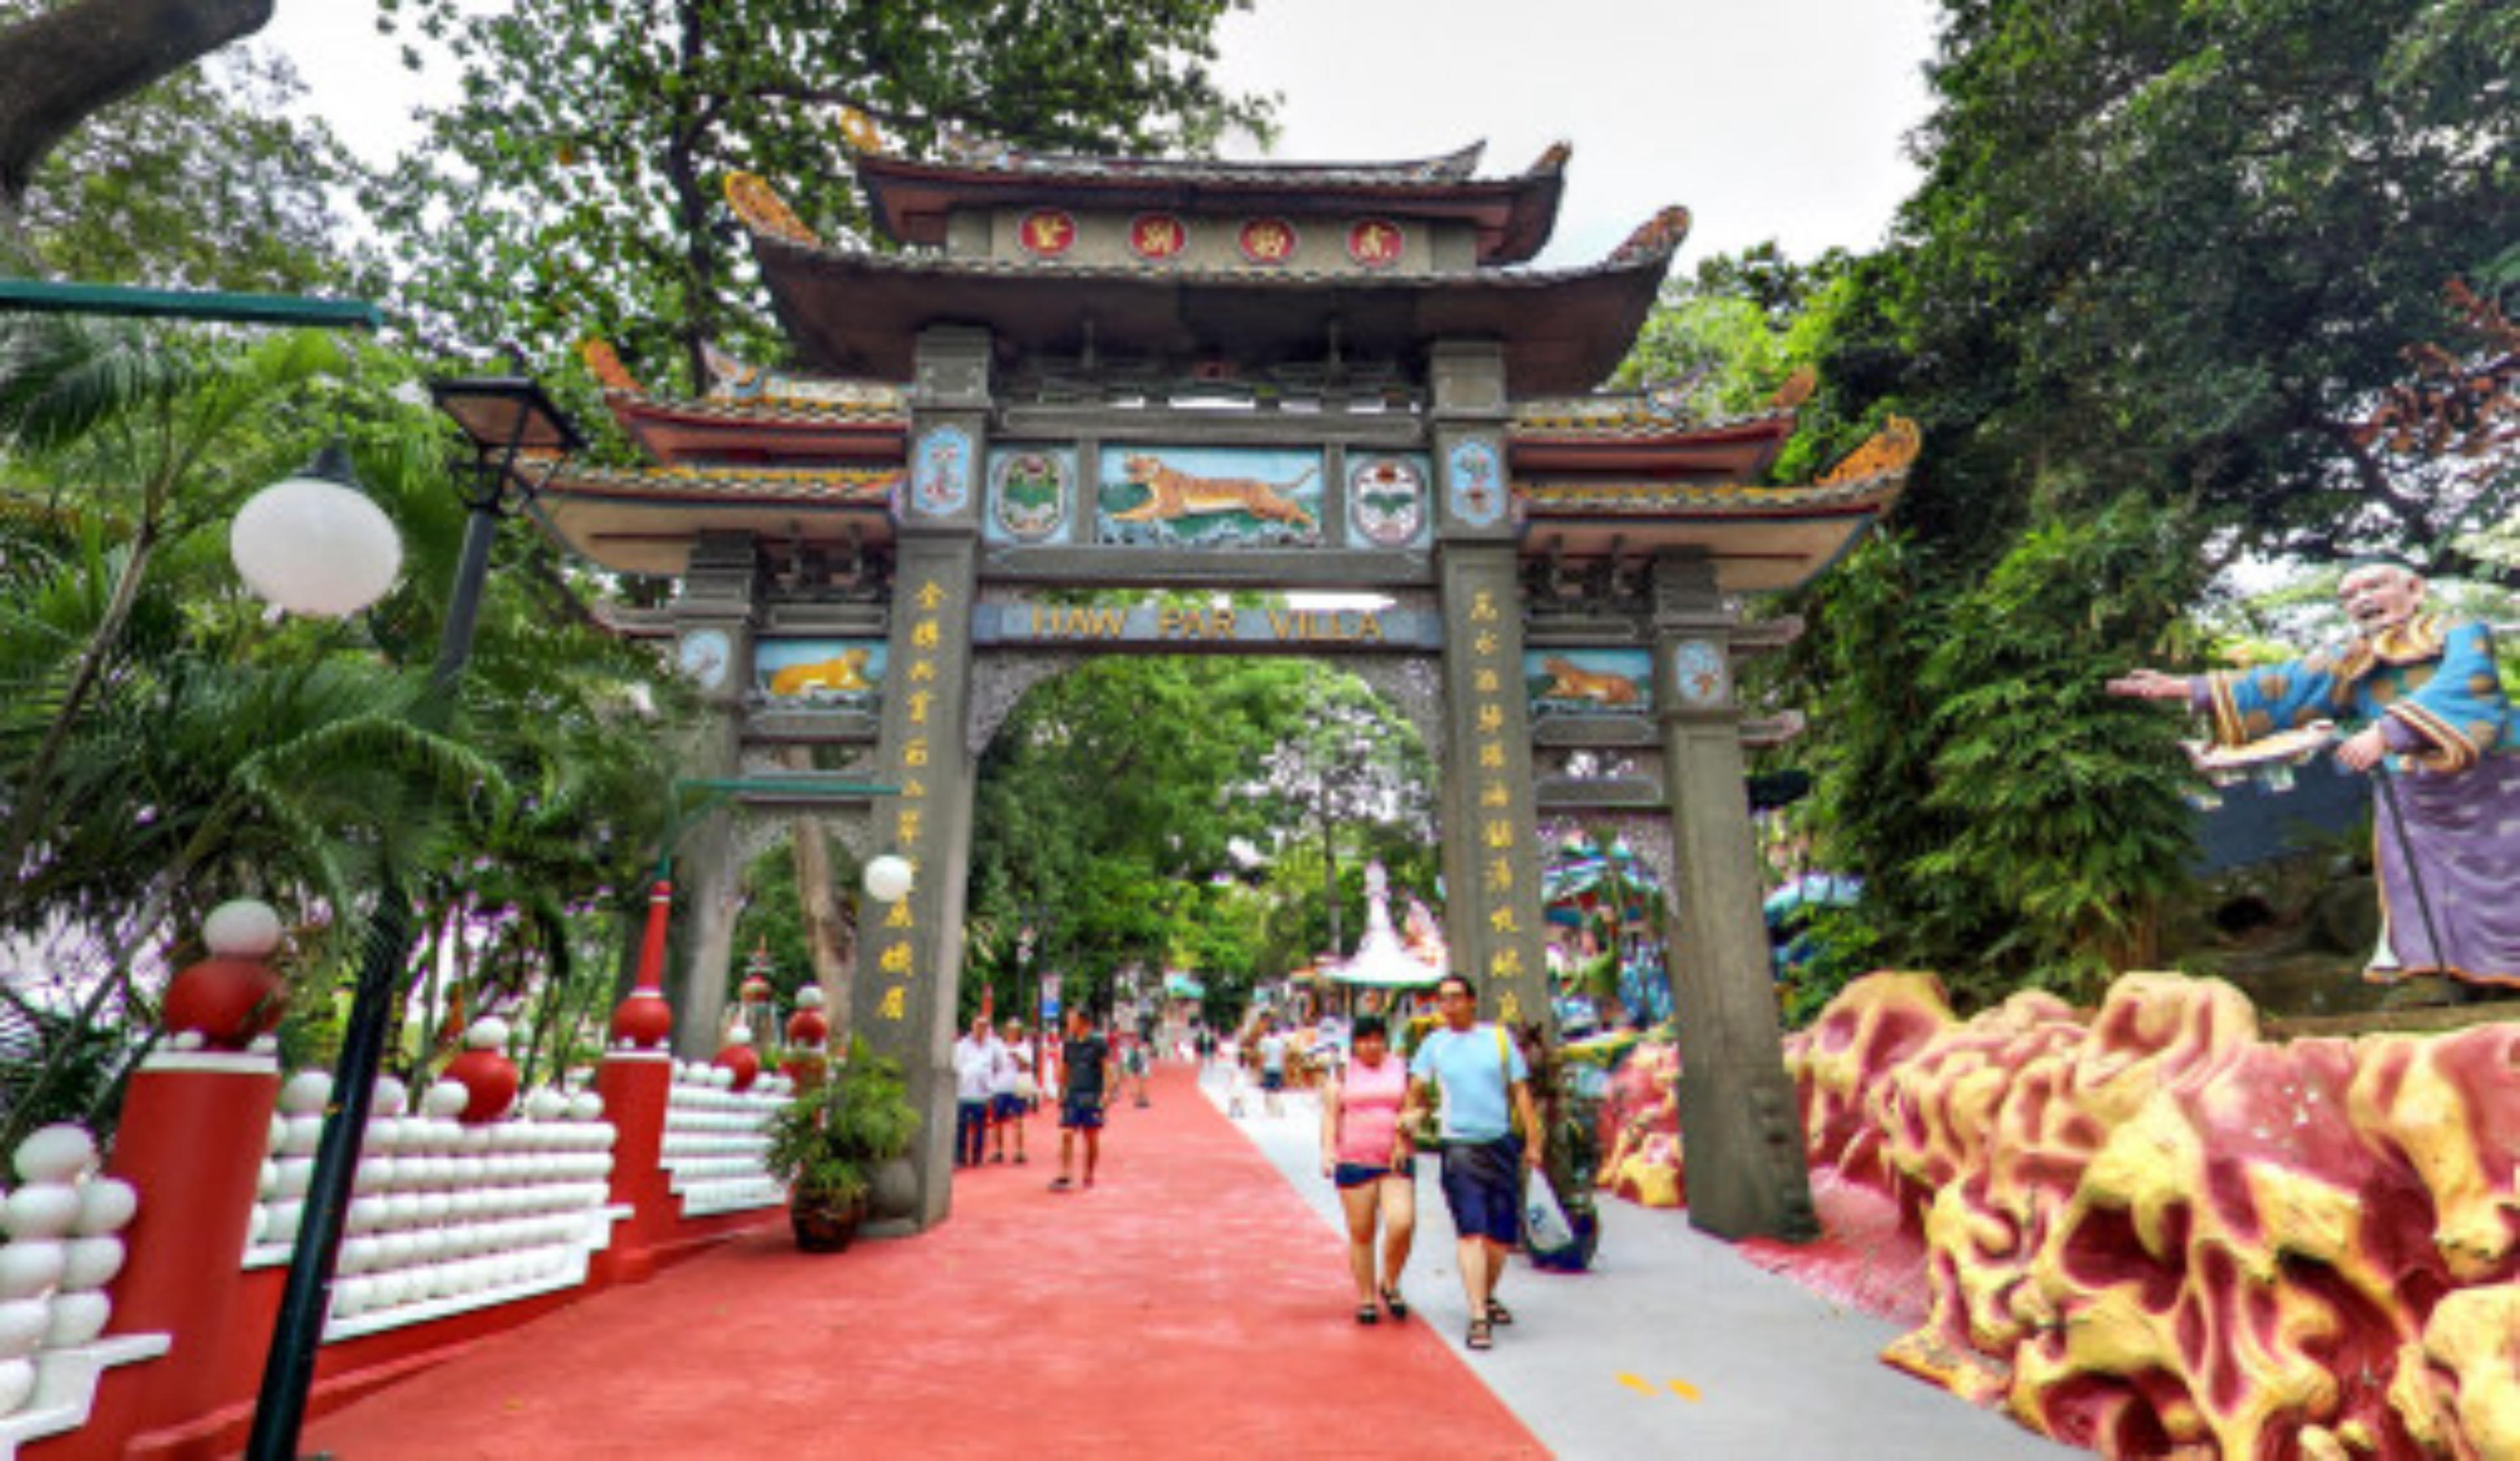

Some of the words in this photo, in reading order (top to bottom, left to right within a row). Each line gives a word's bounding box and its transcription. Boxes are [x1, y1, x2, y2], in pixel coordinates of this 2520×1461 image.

[1032, 606, 1127, 636] HAW
[1159, 608, 1235, 638] PAR
[1268, 608, 1385, 640] VILLA
